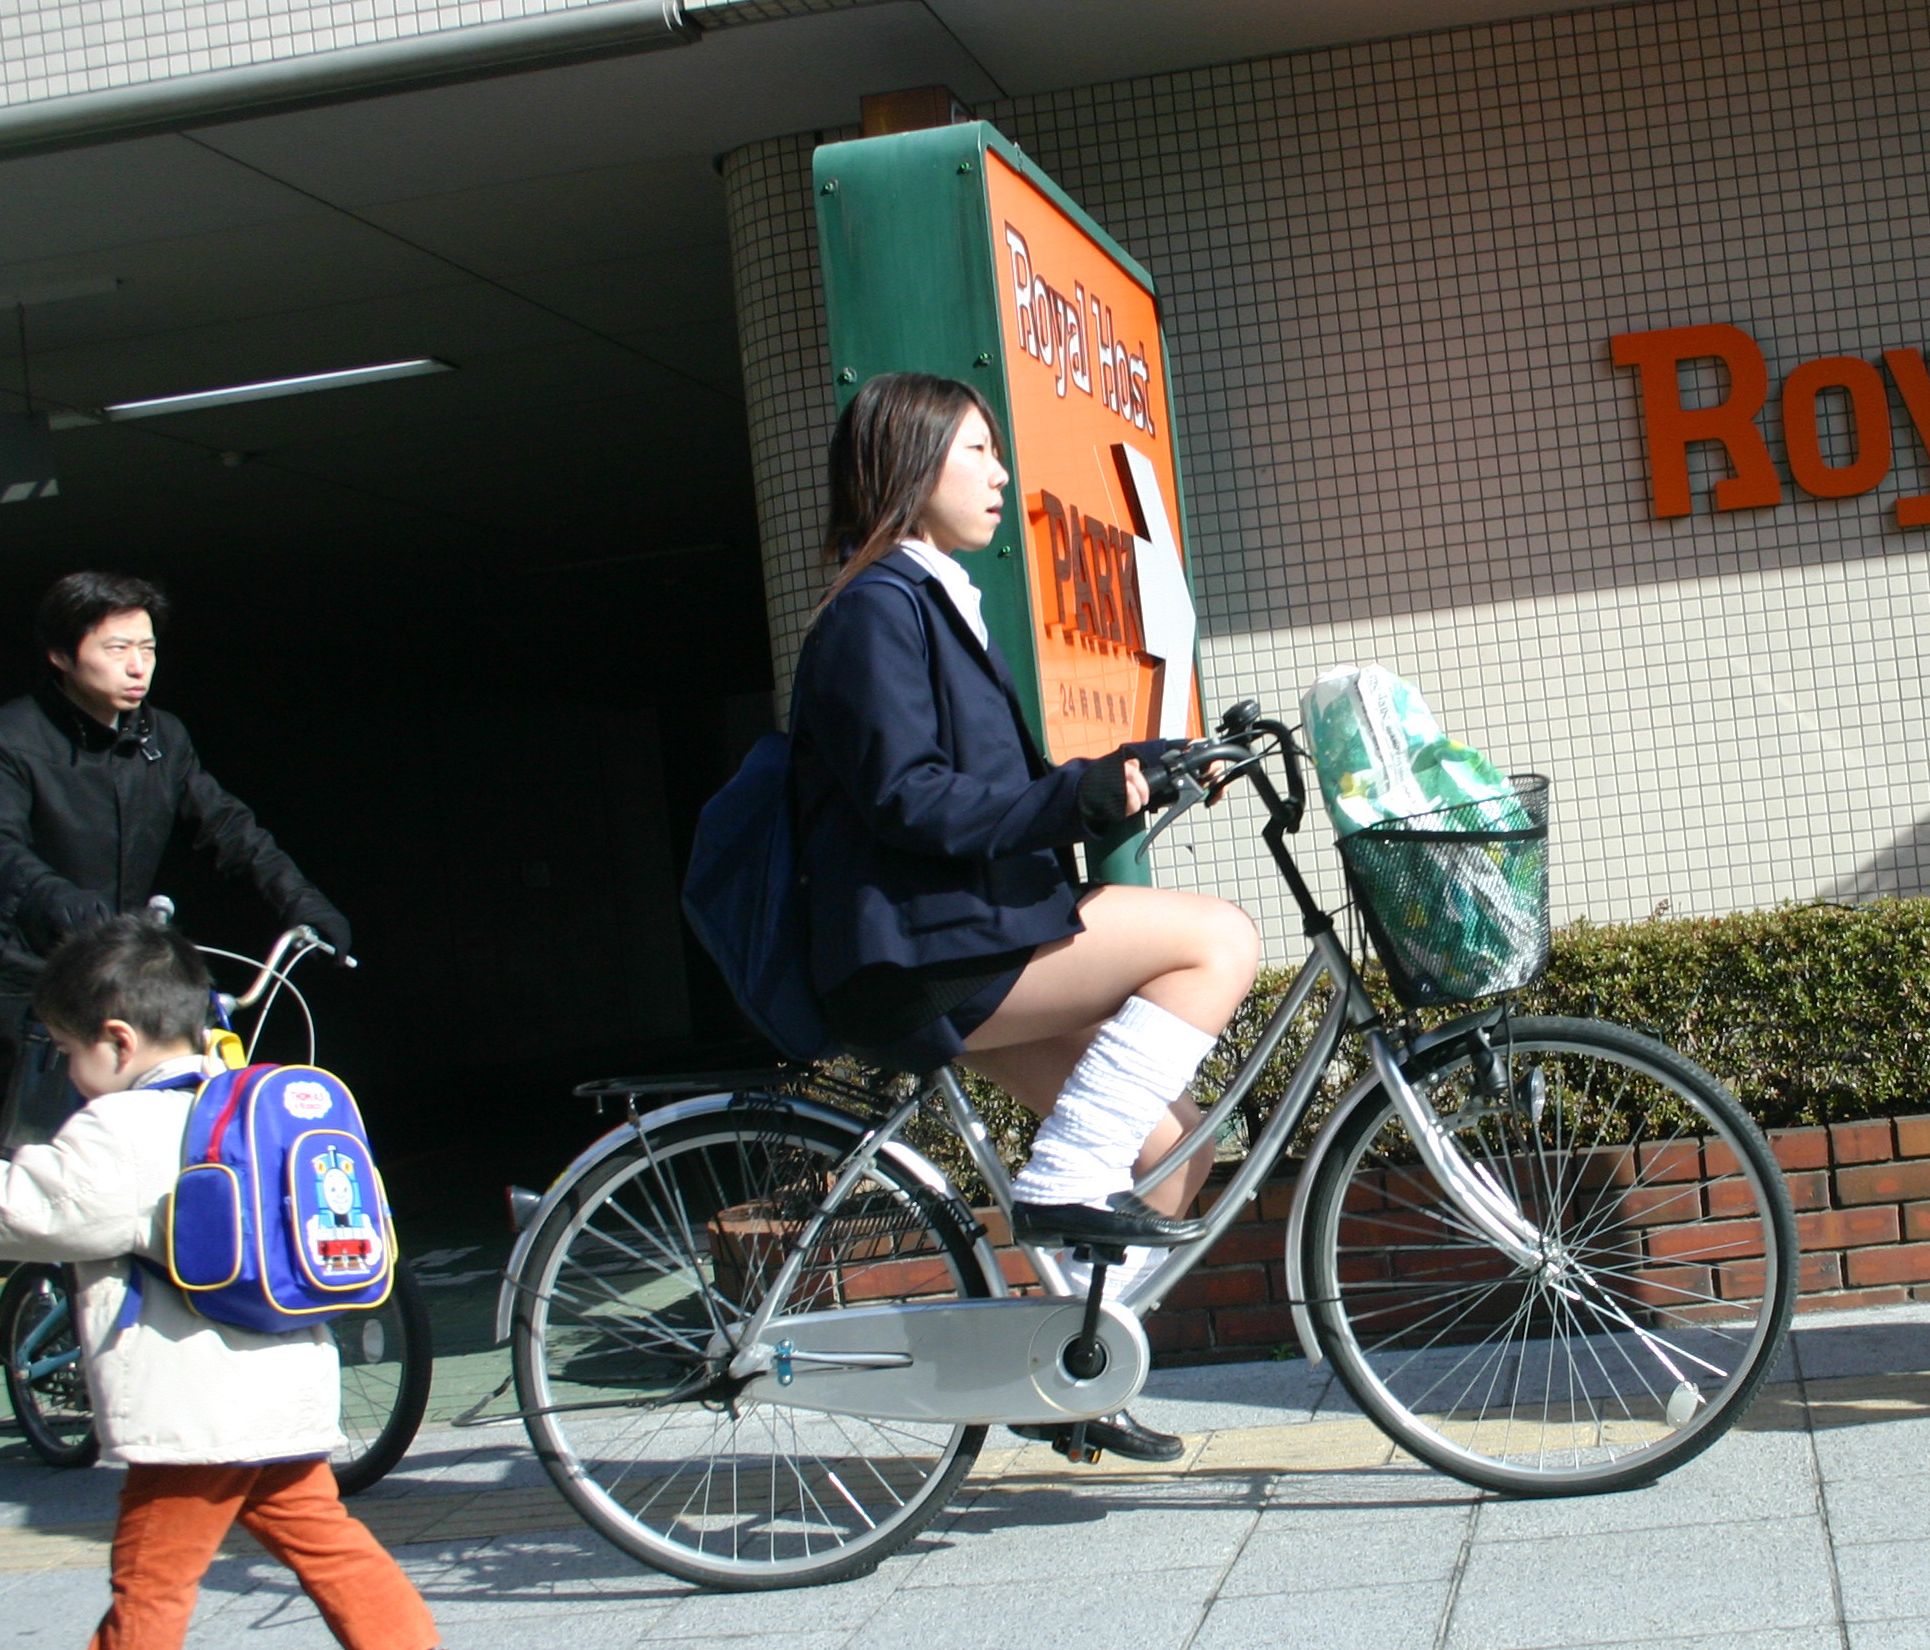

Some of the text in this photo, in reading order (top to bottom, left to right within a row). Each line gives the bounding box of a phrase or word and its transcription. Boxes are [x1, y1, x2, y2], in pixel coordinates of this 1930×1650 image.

[1004, 219, 1156, 438] Royal Host
[1040, 488, 1147, 652] PARK
